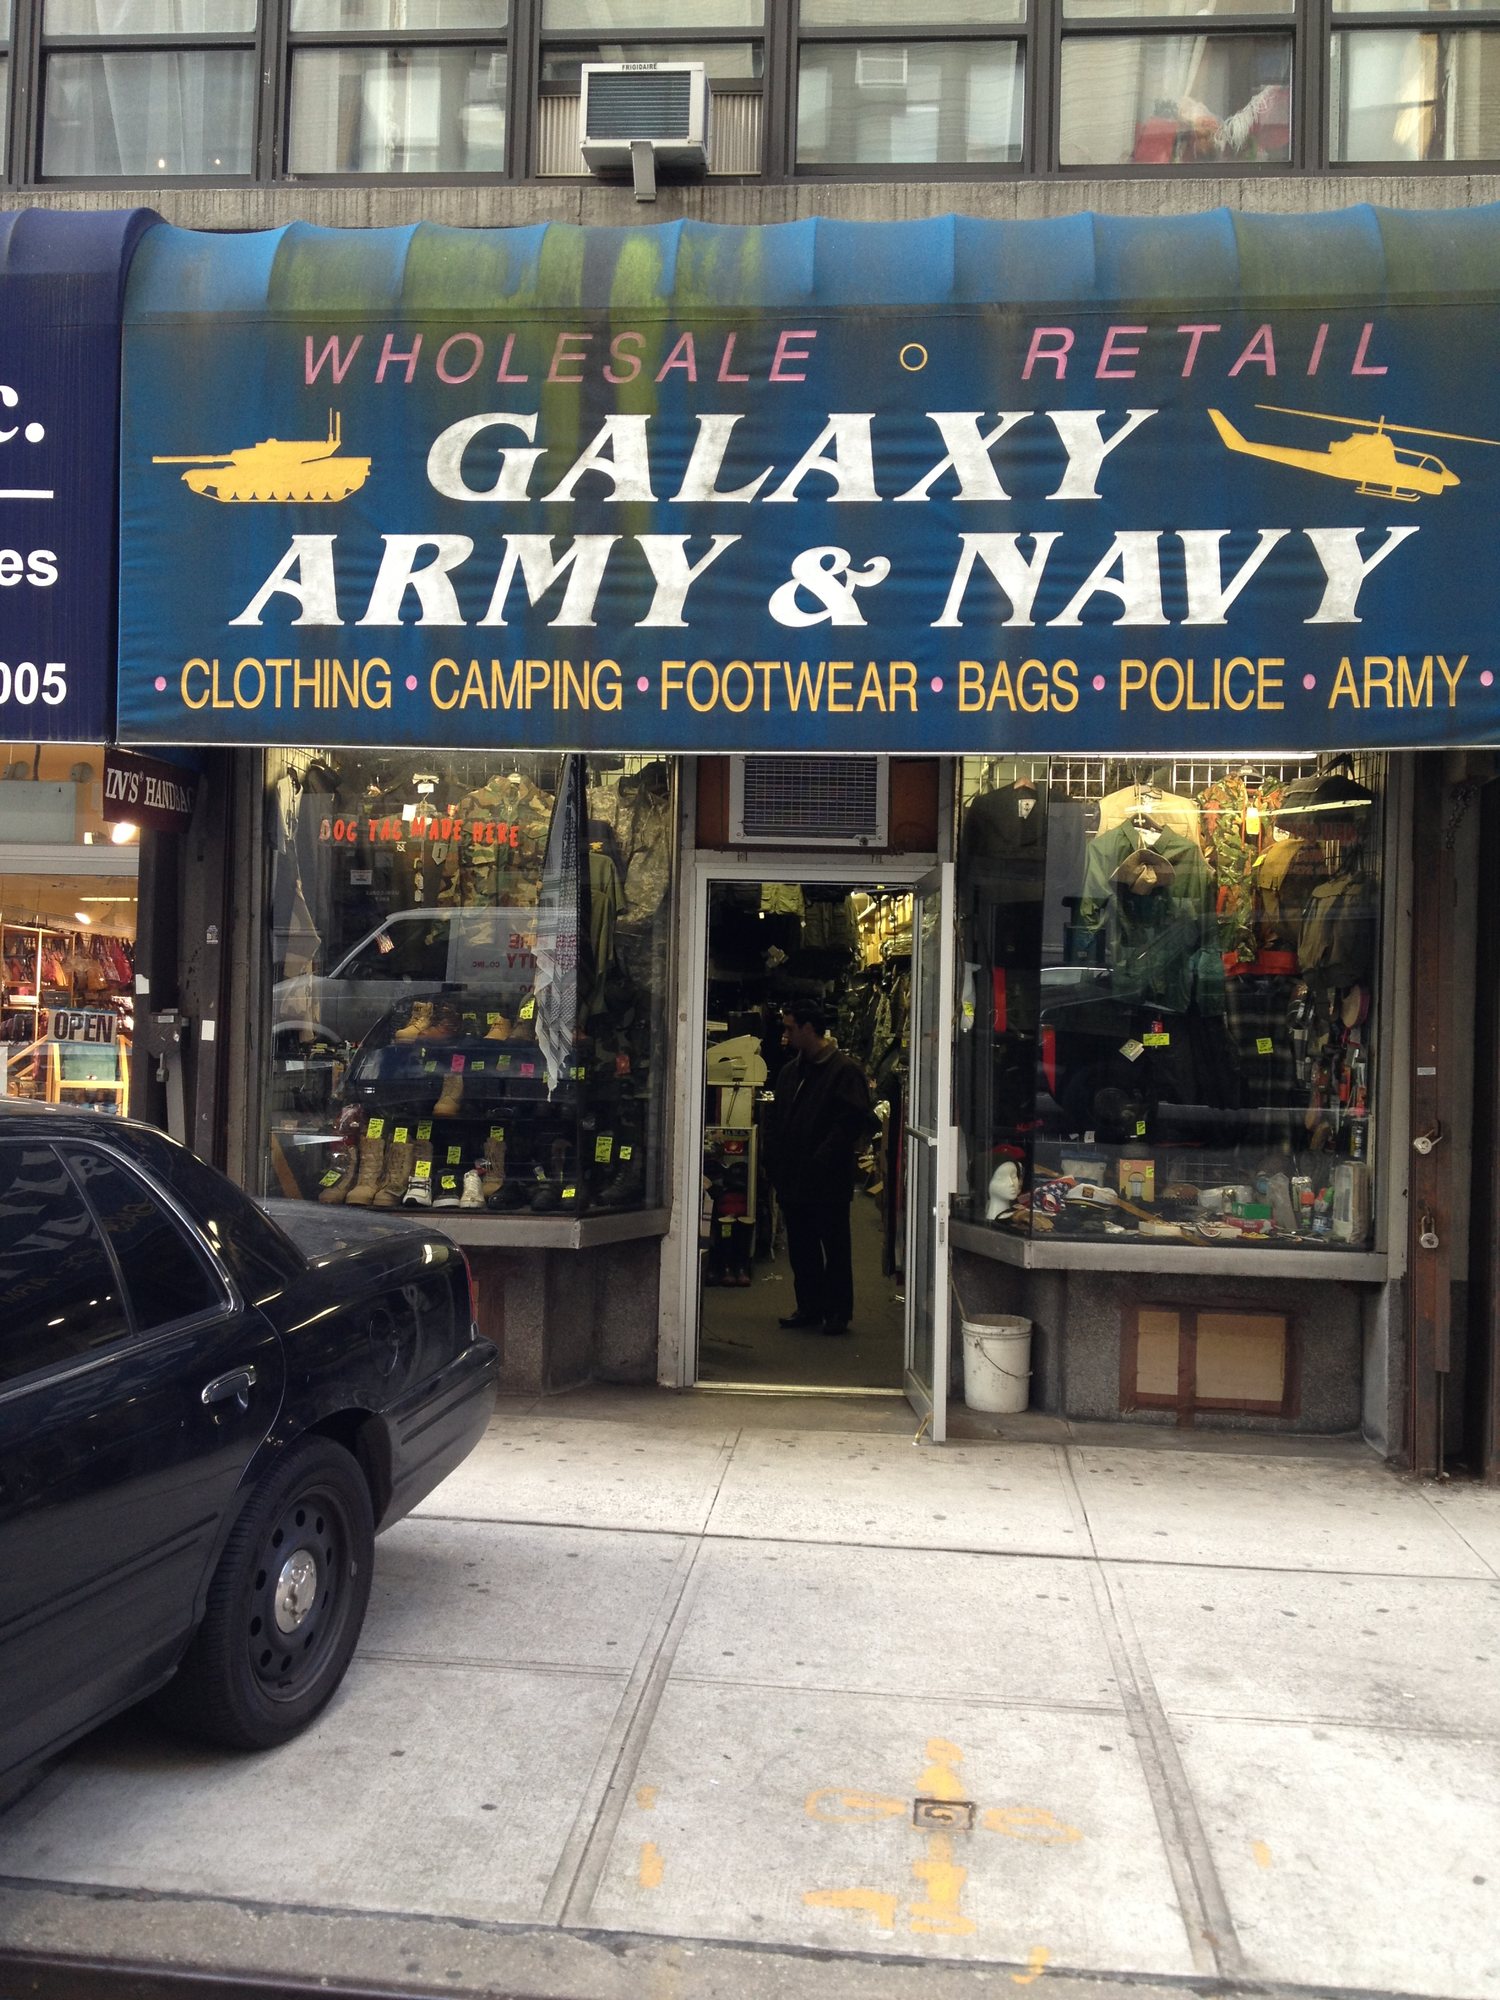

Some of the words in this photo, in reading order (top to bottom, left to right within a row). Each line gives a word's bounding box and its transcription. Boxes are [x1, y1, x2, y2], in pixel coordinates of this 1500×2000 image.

[304, 329, 818, 386] WHOLESALE
[1021, 322, 1389, 381] RETAIL
[426, 408, 1160, 504] GALAXY
[228, 532, 743, 628] ARMY
[768, 545, 892, 628] &
[930, 525, 1421, 628] NAVY
[180, 657, 393, 710] CLOTHING
[429, 657, 624, 712] CAMPING
[660, 659, 919, 713] FOOTWEAR
[957, 657, 1080, 713] BAGS
[1119, 656, 1286, 712] POLICE
[1327, 654, 1470, 710] ARMY
[411, 815, 464, 842] MADE
[472, 820, 520, 849] HERE
[53, 1011, 113, 1043] OPEN
